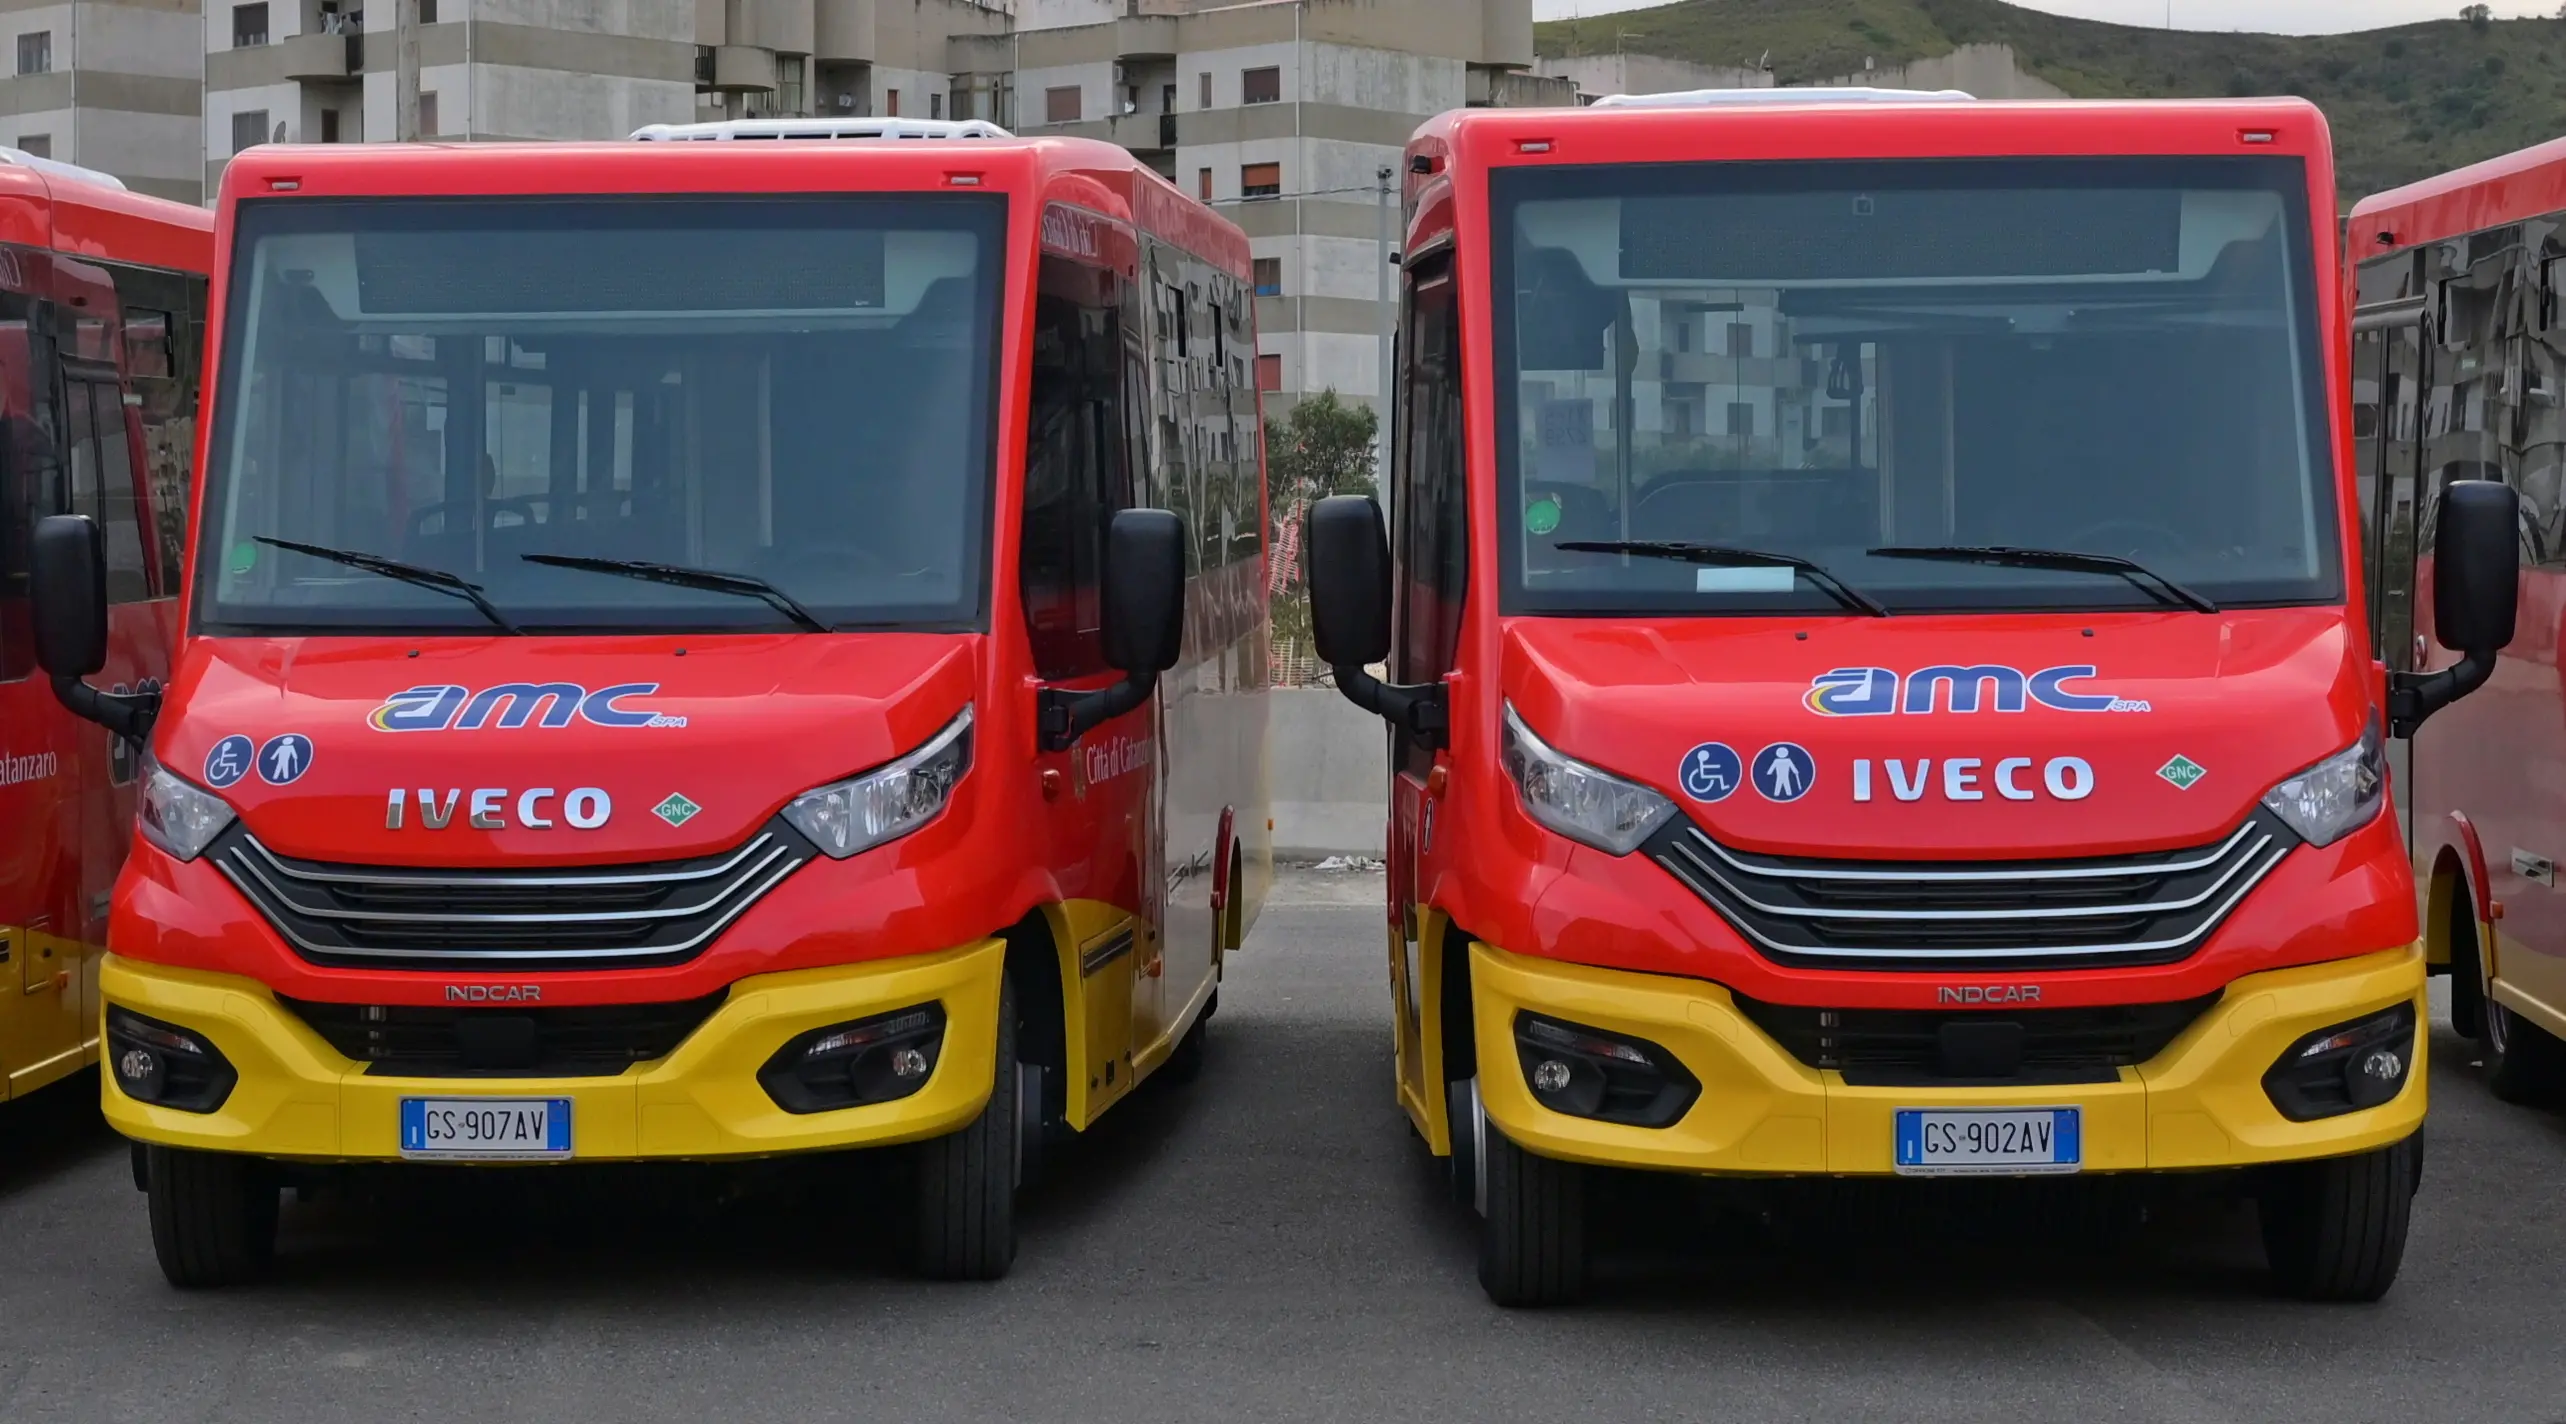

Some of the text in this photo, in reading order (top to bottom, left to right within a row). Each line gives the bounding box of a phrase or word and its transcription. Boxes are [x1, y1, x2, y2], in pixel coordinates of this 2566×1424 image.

[2111, 700, 2151, 712] SPA
[649, 716, 688, 728] SPA
[1110, 736, 1119, 776] di
[1853, 756, 2094, 801] IVECO
[2166, 765, 2197, 780] GNC
[385, 787, 611, 830] IVECO
[661, 803, 691, 817] GNC
[444, 985, 541, 1001] INDCAR
[1937, 985, 2041, 1003] INDCAR
